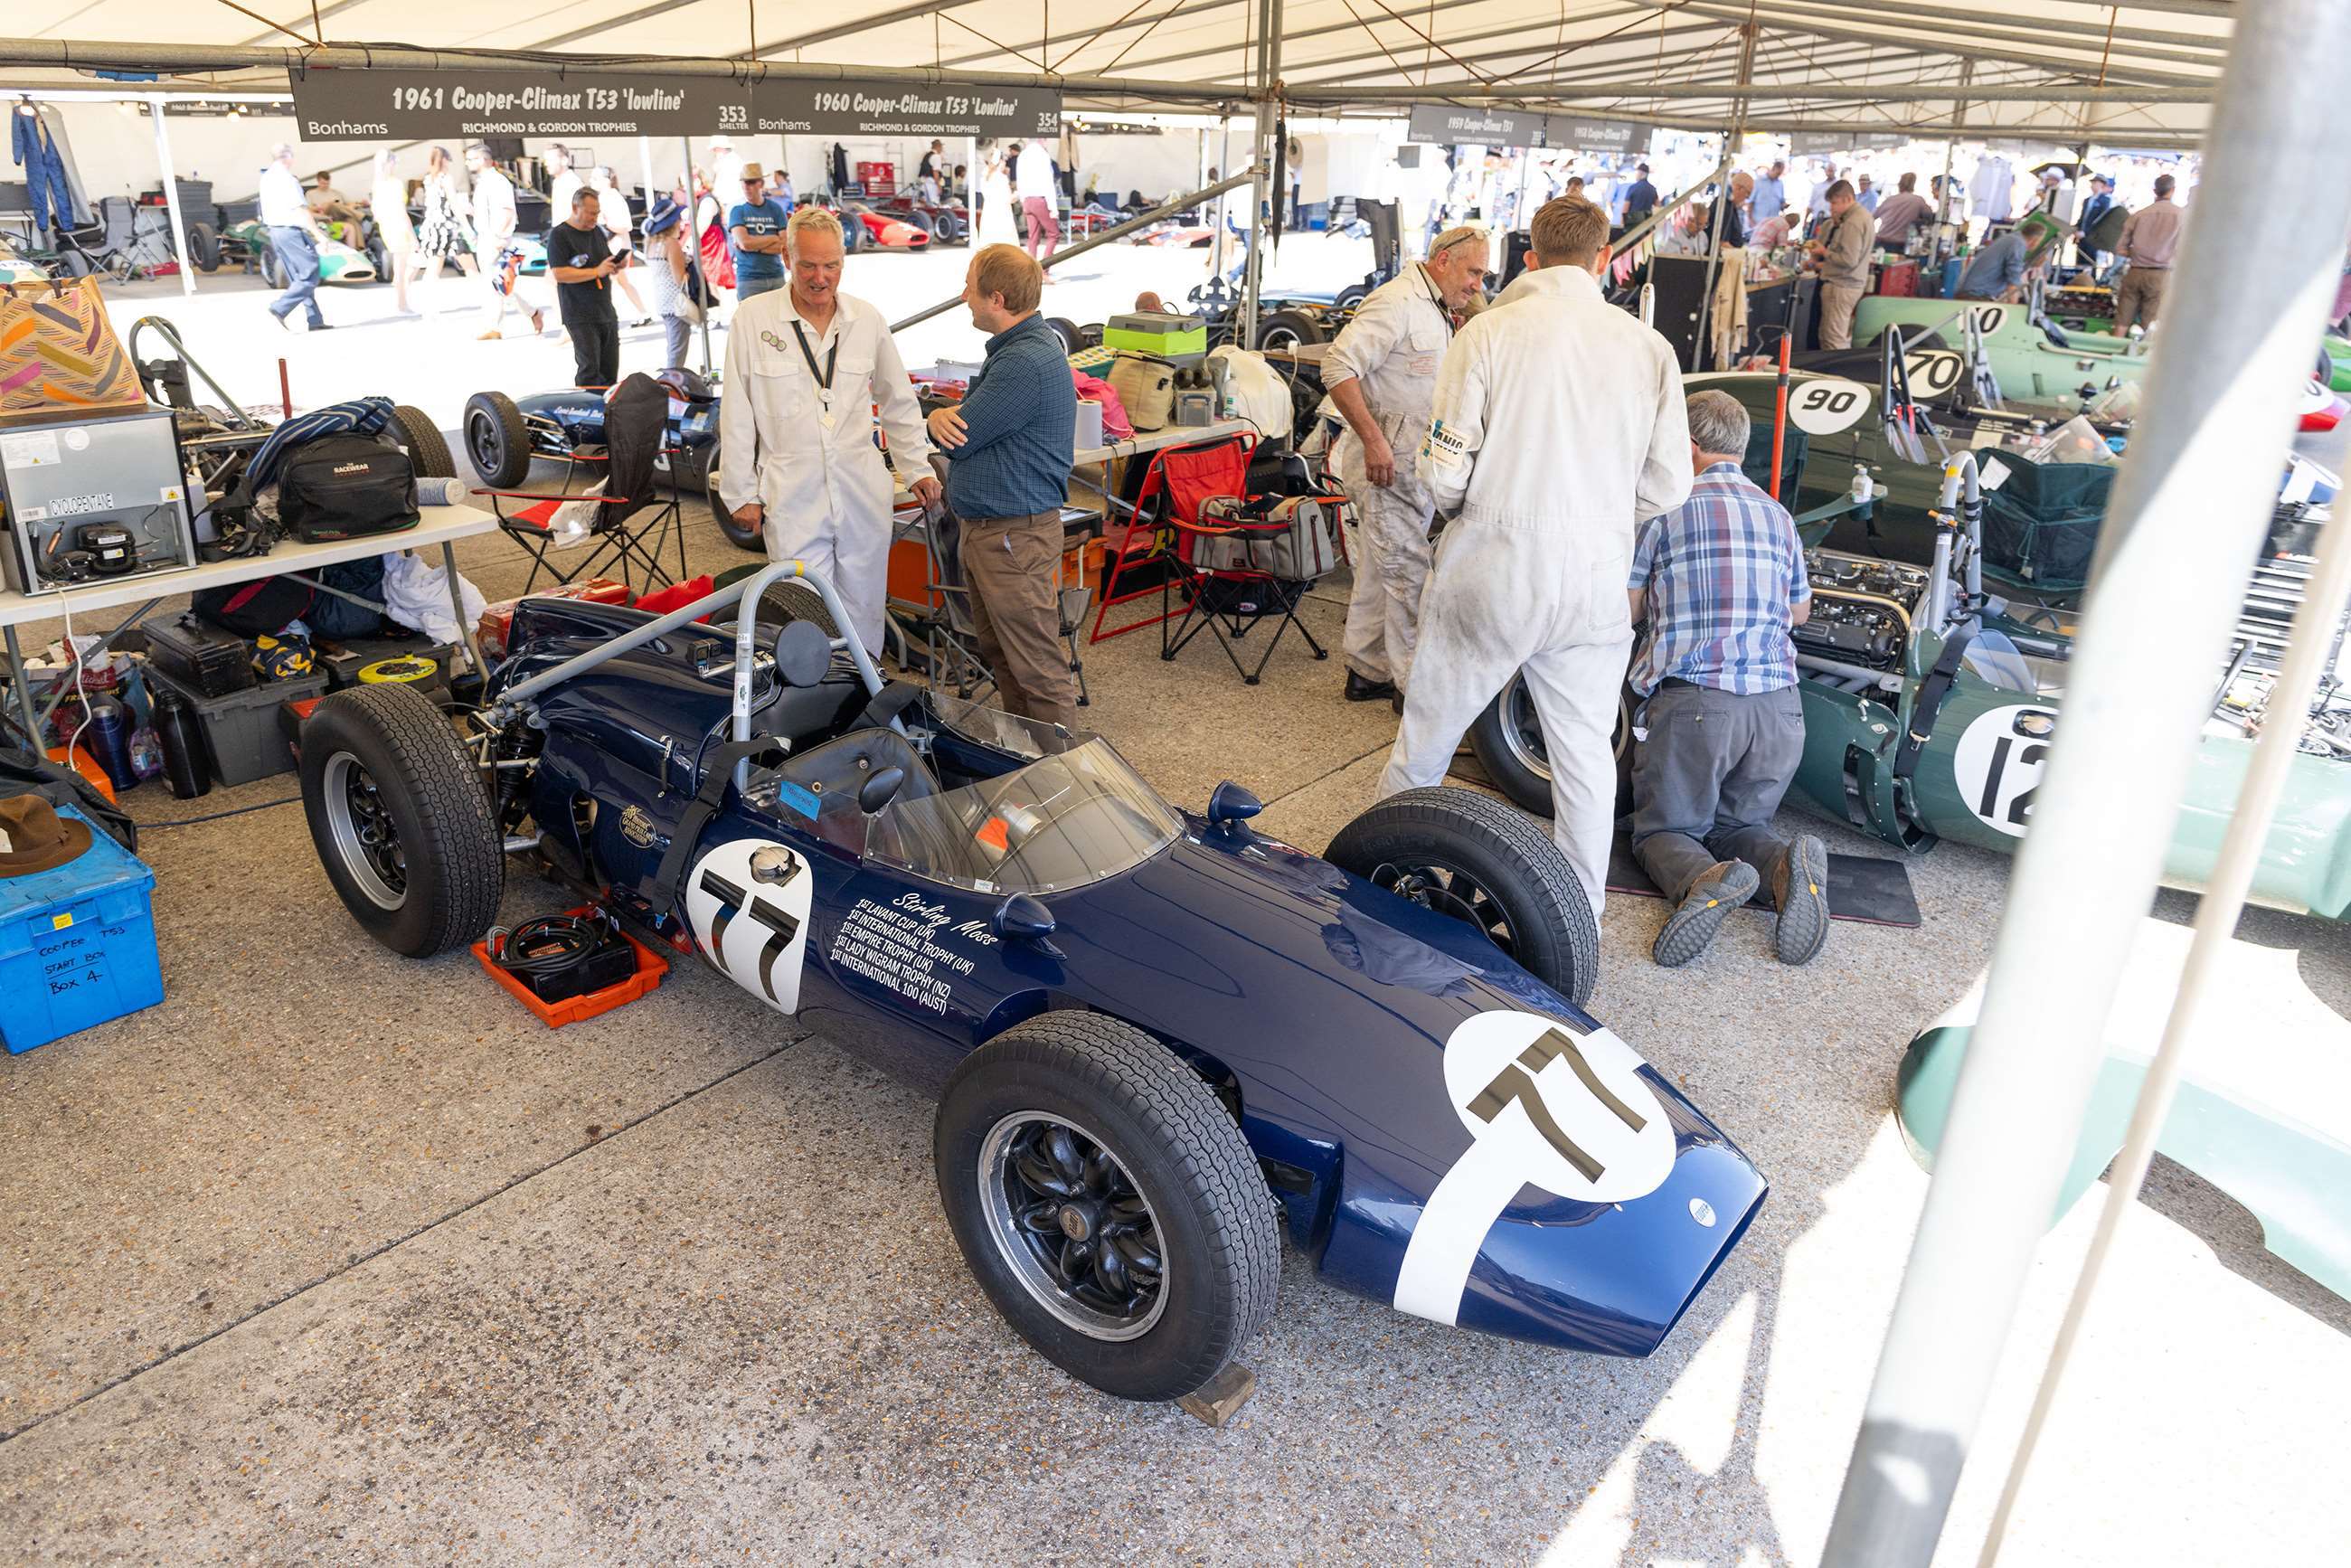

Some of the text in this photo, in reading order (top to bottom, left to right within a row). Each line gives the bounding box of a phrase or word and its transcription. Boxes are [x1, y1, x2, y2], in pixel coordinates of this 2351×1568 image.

[392, 87, 444, 110] 1961
[452, 86, 582, 117] Cooper-Climax
[587, 87, 618, 110] T53
[814, 92, 850, 112] 1960
[853, 92, 941, 118] Cooper-Climax
[945, 97, 968, 116] T53
[307, 119, 389, 135] Bonhams
[719, 106, 747, 123] 353
[719, 122, 749, 130] SHELTER
[758, 118, 811, 130] Bonhams
[1037, 112, 1059, 127] 354
[462, 122, 637, 134] RICHMOND & GORDON TROPHIES
[860, 121, 980, 134] RICHMOND & GORDON TROPHIES
[1906, 353, 1960, 390] 70
[1801, 389, 1857, 413] 90
[334, 463, 369, 473] RACEWEAR
[50, 493, 113, 515] CYCLOPENTANE
[855, 898, 935, 940] 1ST LAVANT CUP (UK)
[892, 893, 998, 945] Stirling Moss
[39, 926, 126, 957] COOPER T53
[699, 868, 800, 1005] 77
[840, 921, 933, 973] 1ST EMPIRE TROPHY (UK)
[847, 909, 974, 976] 1ST INTERNATIONAL TROPHY (UK)
[44, 959, 75, 975] START
[87, 970, 102, 983] 4
[835, 935, 950, 999] 1ST LADY WIGRAM TROPHY (NZ)
[830, 949, 947, 1015] 1ST INTERNATIONAL 100 (AUST)
[1466, 1026, 1648, 1185] 77
